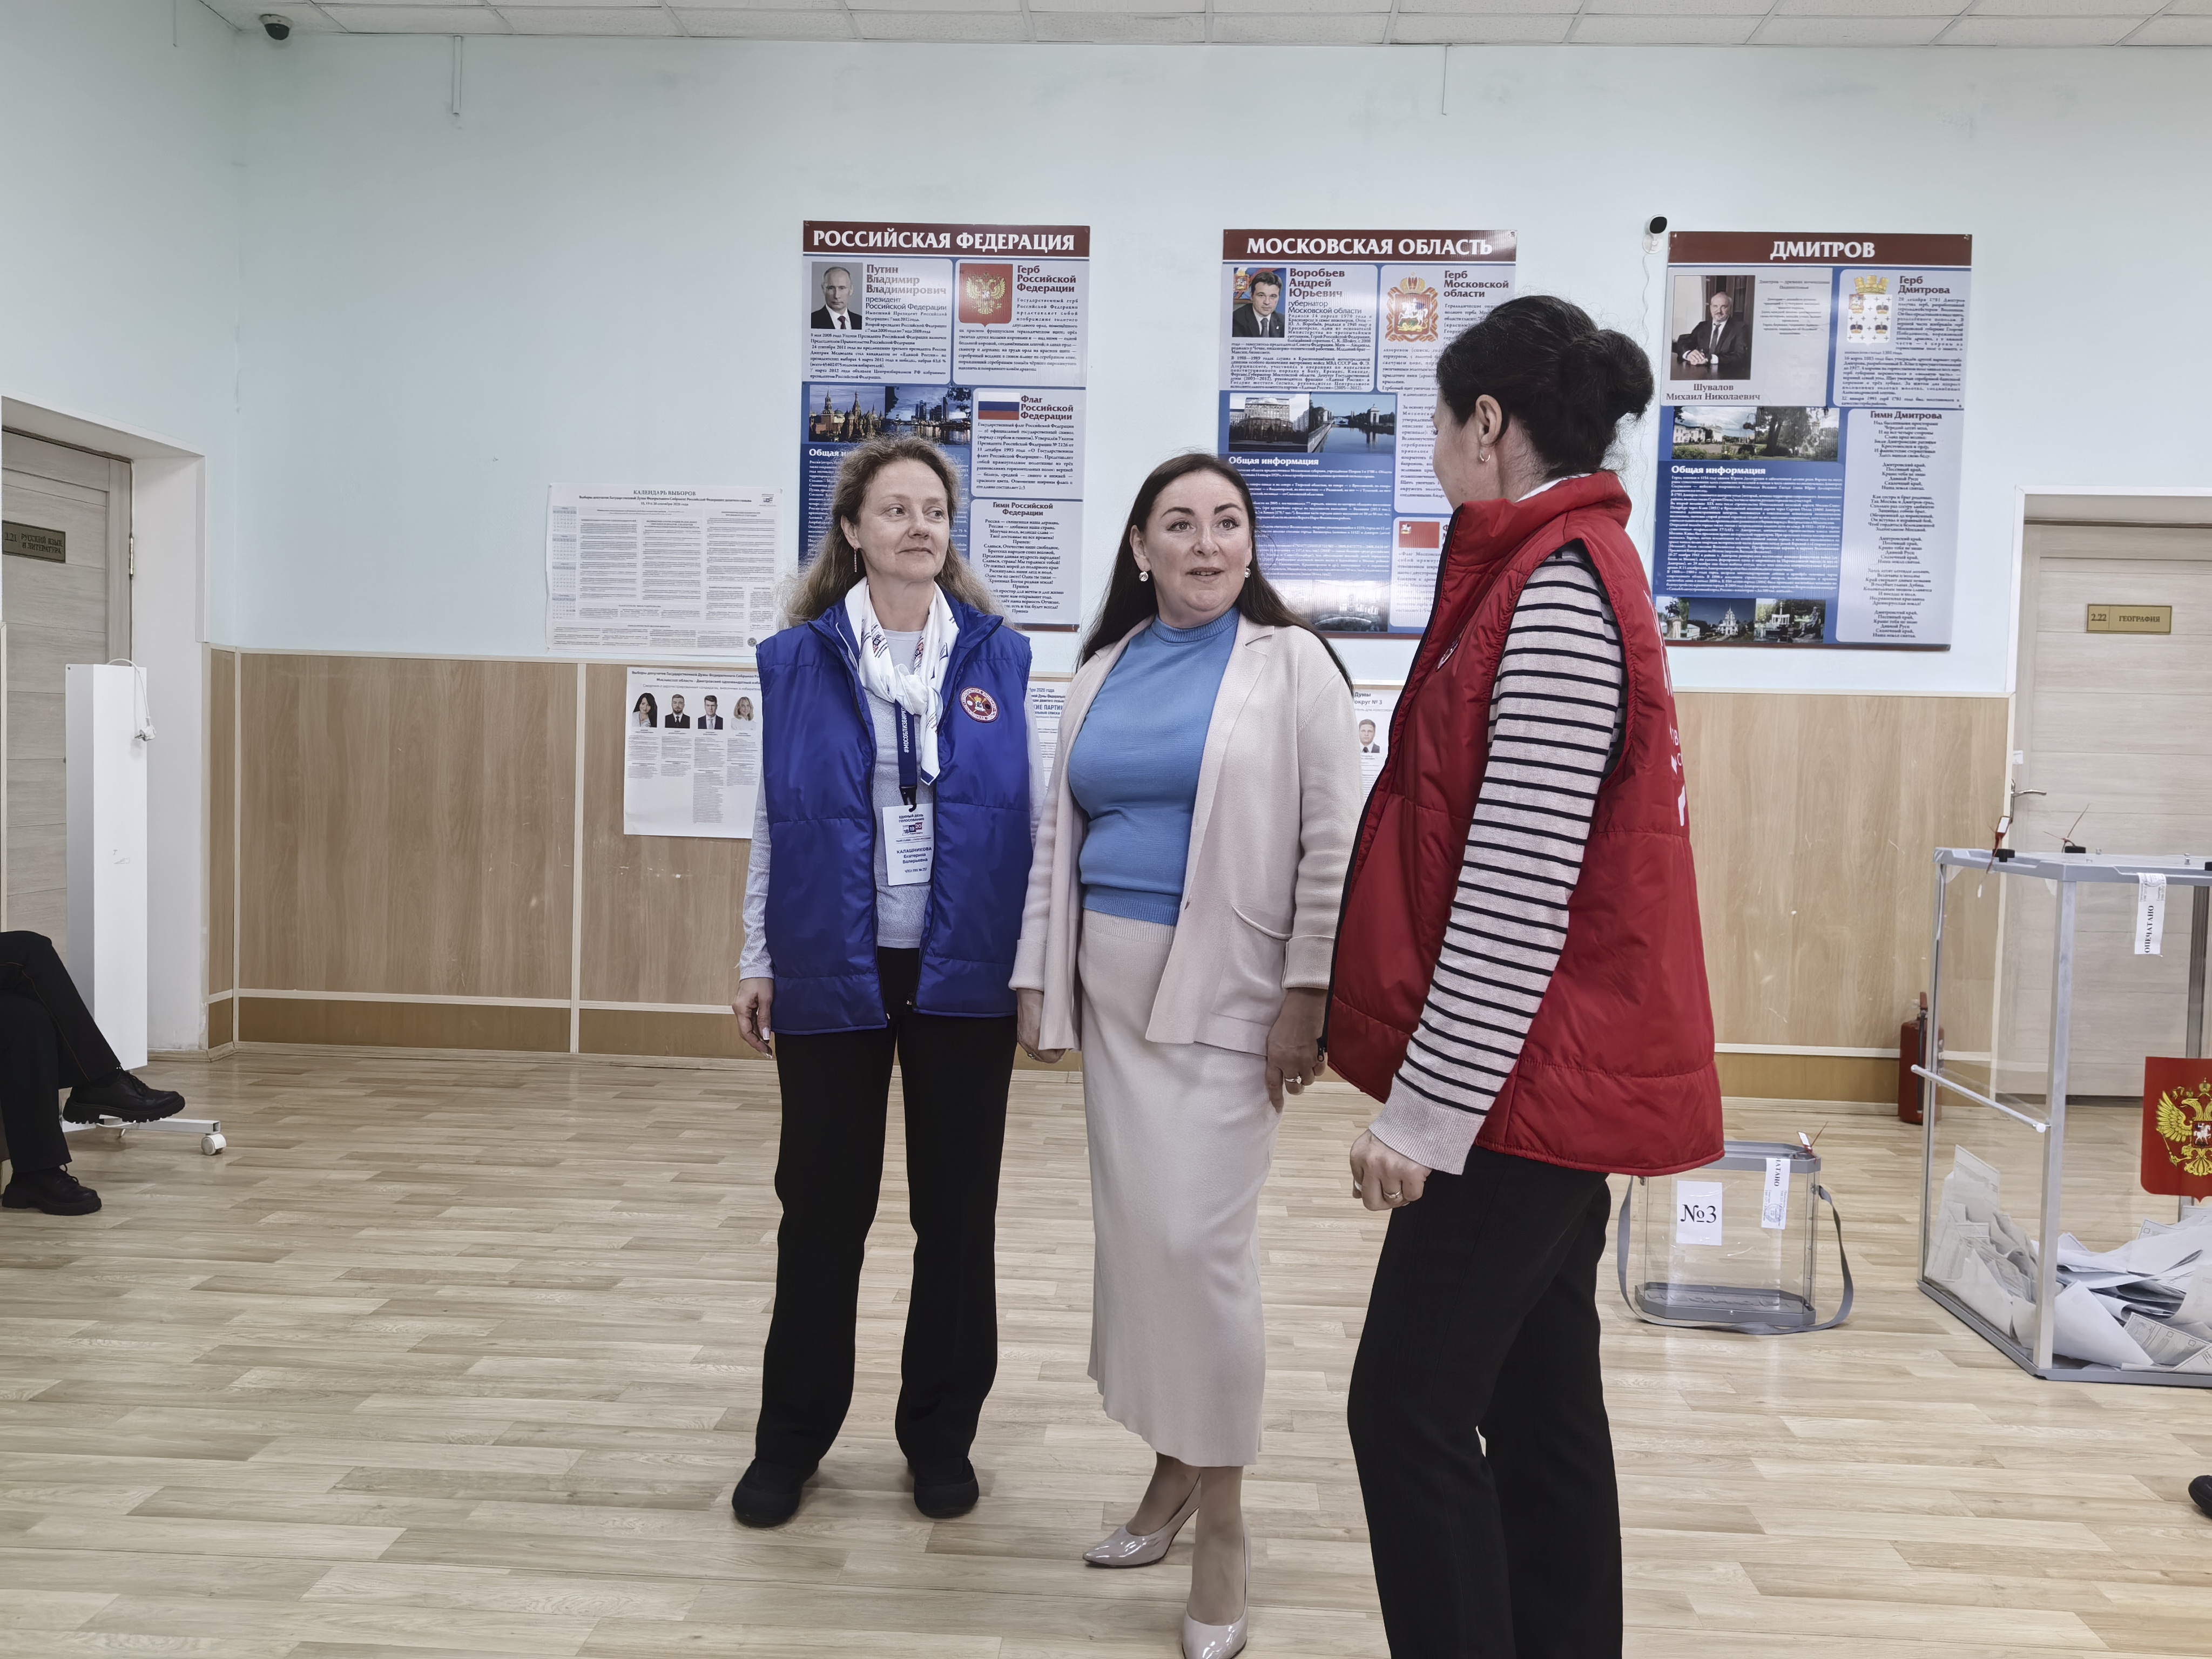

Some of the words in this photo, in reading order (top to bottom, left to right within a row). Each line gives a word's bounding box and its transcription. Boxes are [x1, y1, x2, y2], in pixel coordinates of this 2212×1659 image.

[814, 228, 950, 248] РОССИЙСКАЯ
[956, 231, 1075, 252] ФЕДЕРАЦИЯ
[1247, 238, 1393, 255] МОСКОВСКАЯ
[1399, 239, 1492, 256] ОБЛАСТЬ
[1770, 241, 1874, 260] ДМИТРОВ
[867, 264, 899, 275] Путин
[1017, 265, 1040, 275] Герб
[1290, 268, 1345, 280] Воробьев
[867, 274, 920, 285] Владимир
[1017, 274, 1076, 283] Российской
[1445, 270, 1467, 282] Герб
[1899, 276, 1923, 286] Герб
[1017, 283, 1075, 293] Федерации
[1289, 279, 1331, 290] Андрей
[1444, 280, 1509, 290] Московской
[866, 285, 946, 295] Владимирович
[1289, 288, 1342, 299] Юрьевич
[1444, 289, 1485, 299] области
[1898, 285, 1950, 295] Дмитрова
[1694, 383, 1734, 392] Шувалов
[1021, 412, 1072, 421] Федерации
[1894, 411, 1942, 421] Дмитрова
[809, 449, 839, 457] Общая
[1229, 456, 1260, 468] Общая
[1262, 457, 1319, 467] информация
[1671, 465, 1704, 476] Общая
[1706, 466, 1765, 476] информация
[1003, 509, 1043, 517] Федерации
[21, 533, 46, 543] РУССКИЙ
[2091, 613, 2107, 622] 2.22
[2144, 906, 2154, 953] ОПЕЧАТАНО
[1681, 1204, 1717, 1223] №3
